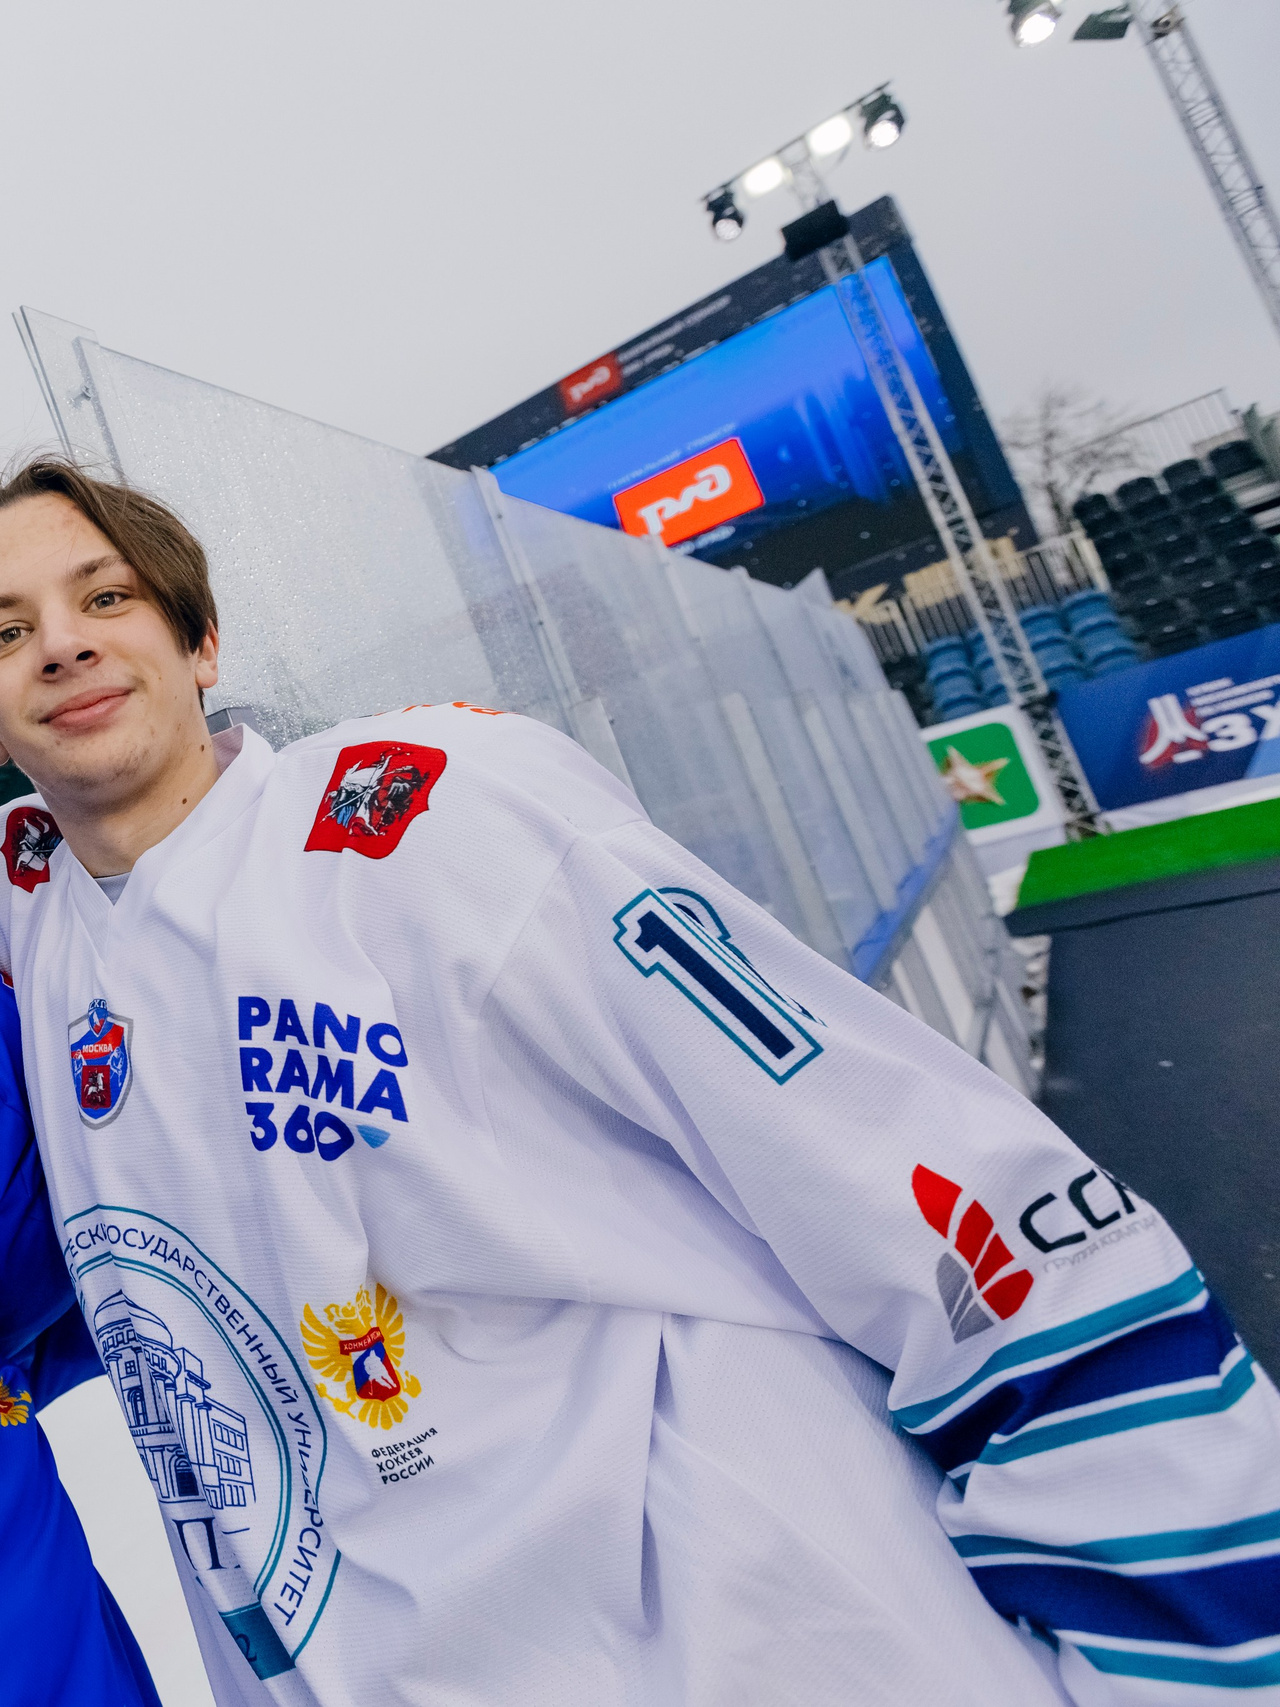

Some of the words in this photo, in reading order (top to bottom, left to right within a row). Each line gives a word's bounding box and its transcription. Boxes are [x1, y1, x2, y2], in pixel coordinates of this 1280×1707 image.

[612, 887, 828, 1086] 1
[82, 1043, 113, 1054] МОСКВА
[238, 996, 408, 1067] PANO
[239, 1047, 409, 1123] RAMA
[245, 1102, 354, 1161] 360
[107, 1224, 299, 1405] ОСУДАРСТВЕННЫЙ
[371, 1427, 438, 1459] ФЕДЕРАЦИЯ
[376, 1447, 423, 1473] ХОККЕЯ
[381, 1455, 435, 1485] РОССИИ
